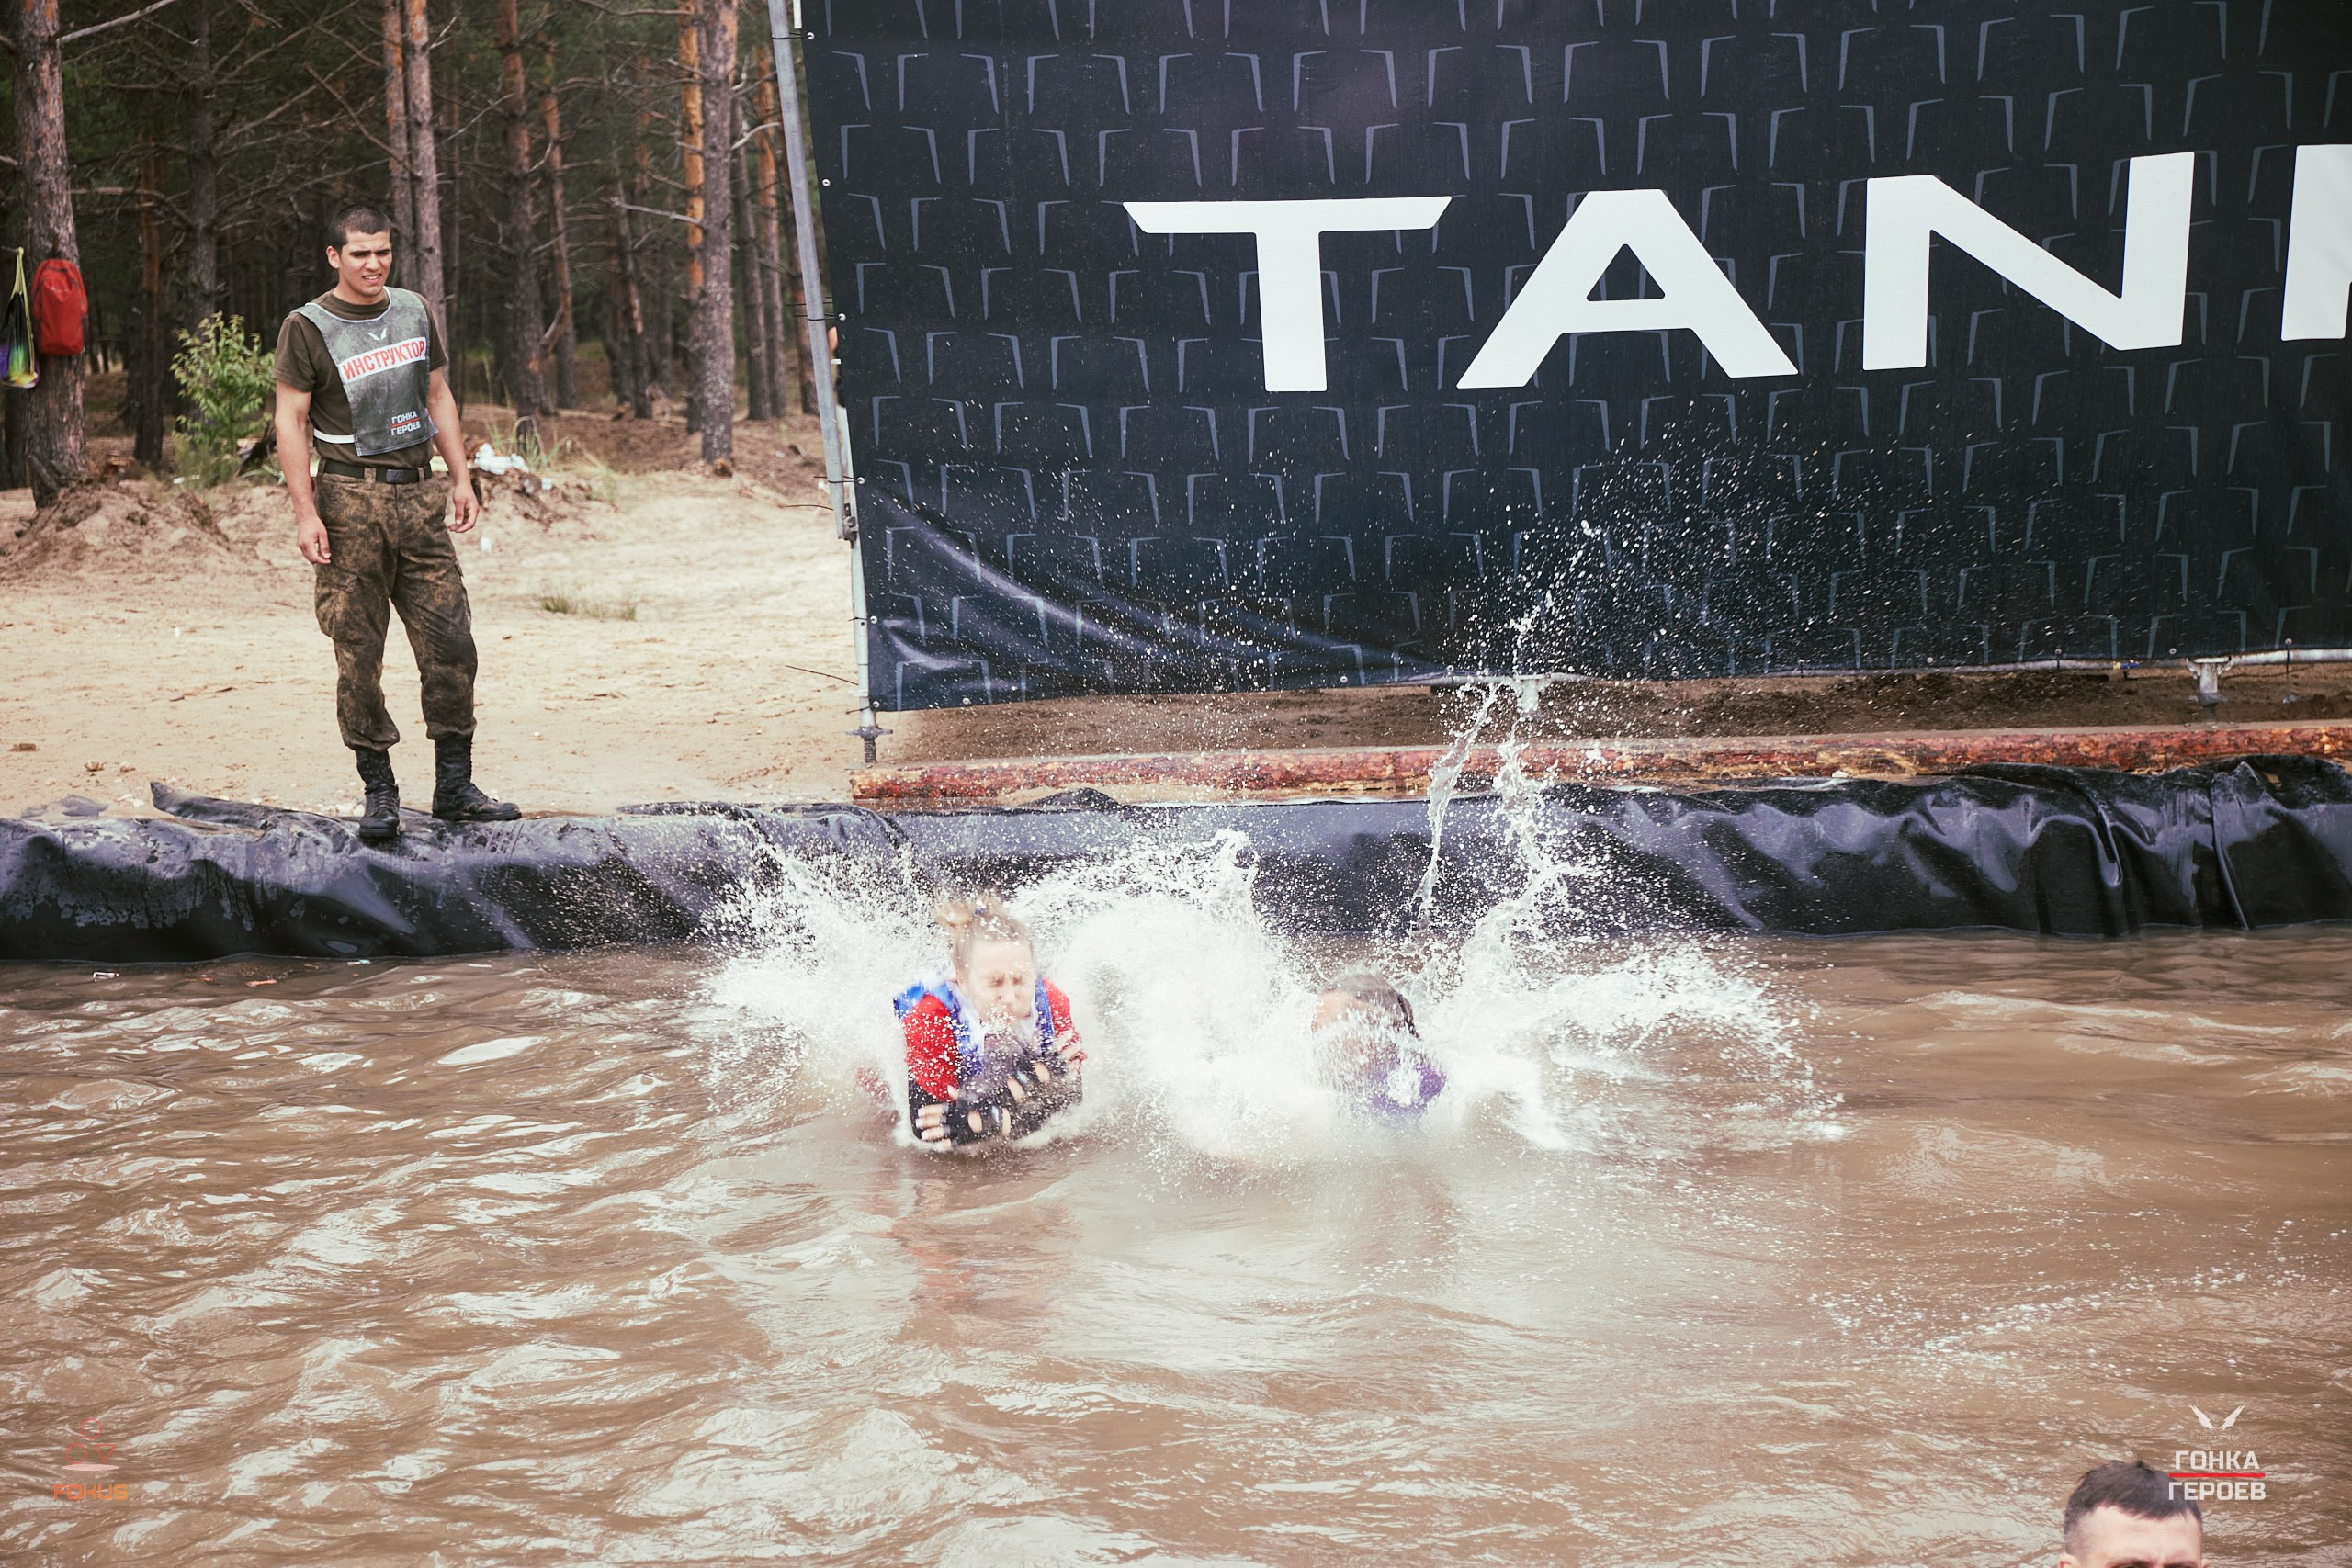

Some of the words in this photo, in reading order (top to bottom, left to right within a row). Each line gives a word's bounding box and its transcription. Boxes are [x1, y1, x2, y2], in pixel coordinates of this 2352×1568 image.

[341, 340, 425, 380] ИНСТРУКТОР
[391, 410, 418, 424] ГОНКА
[390, 420, 421, 436] ГЕРОЕВ
